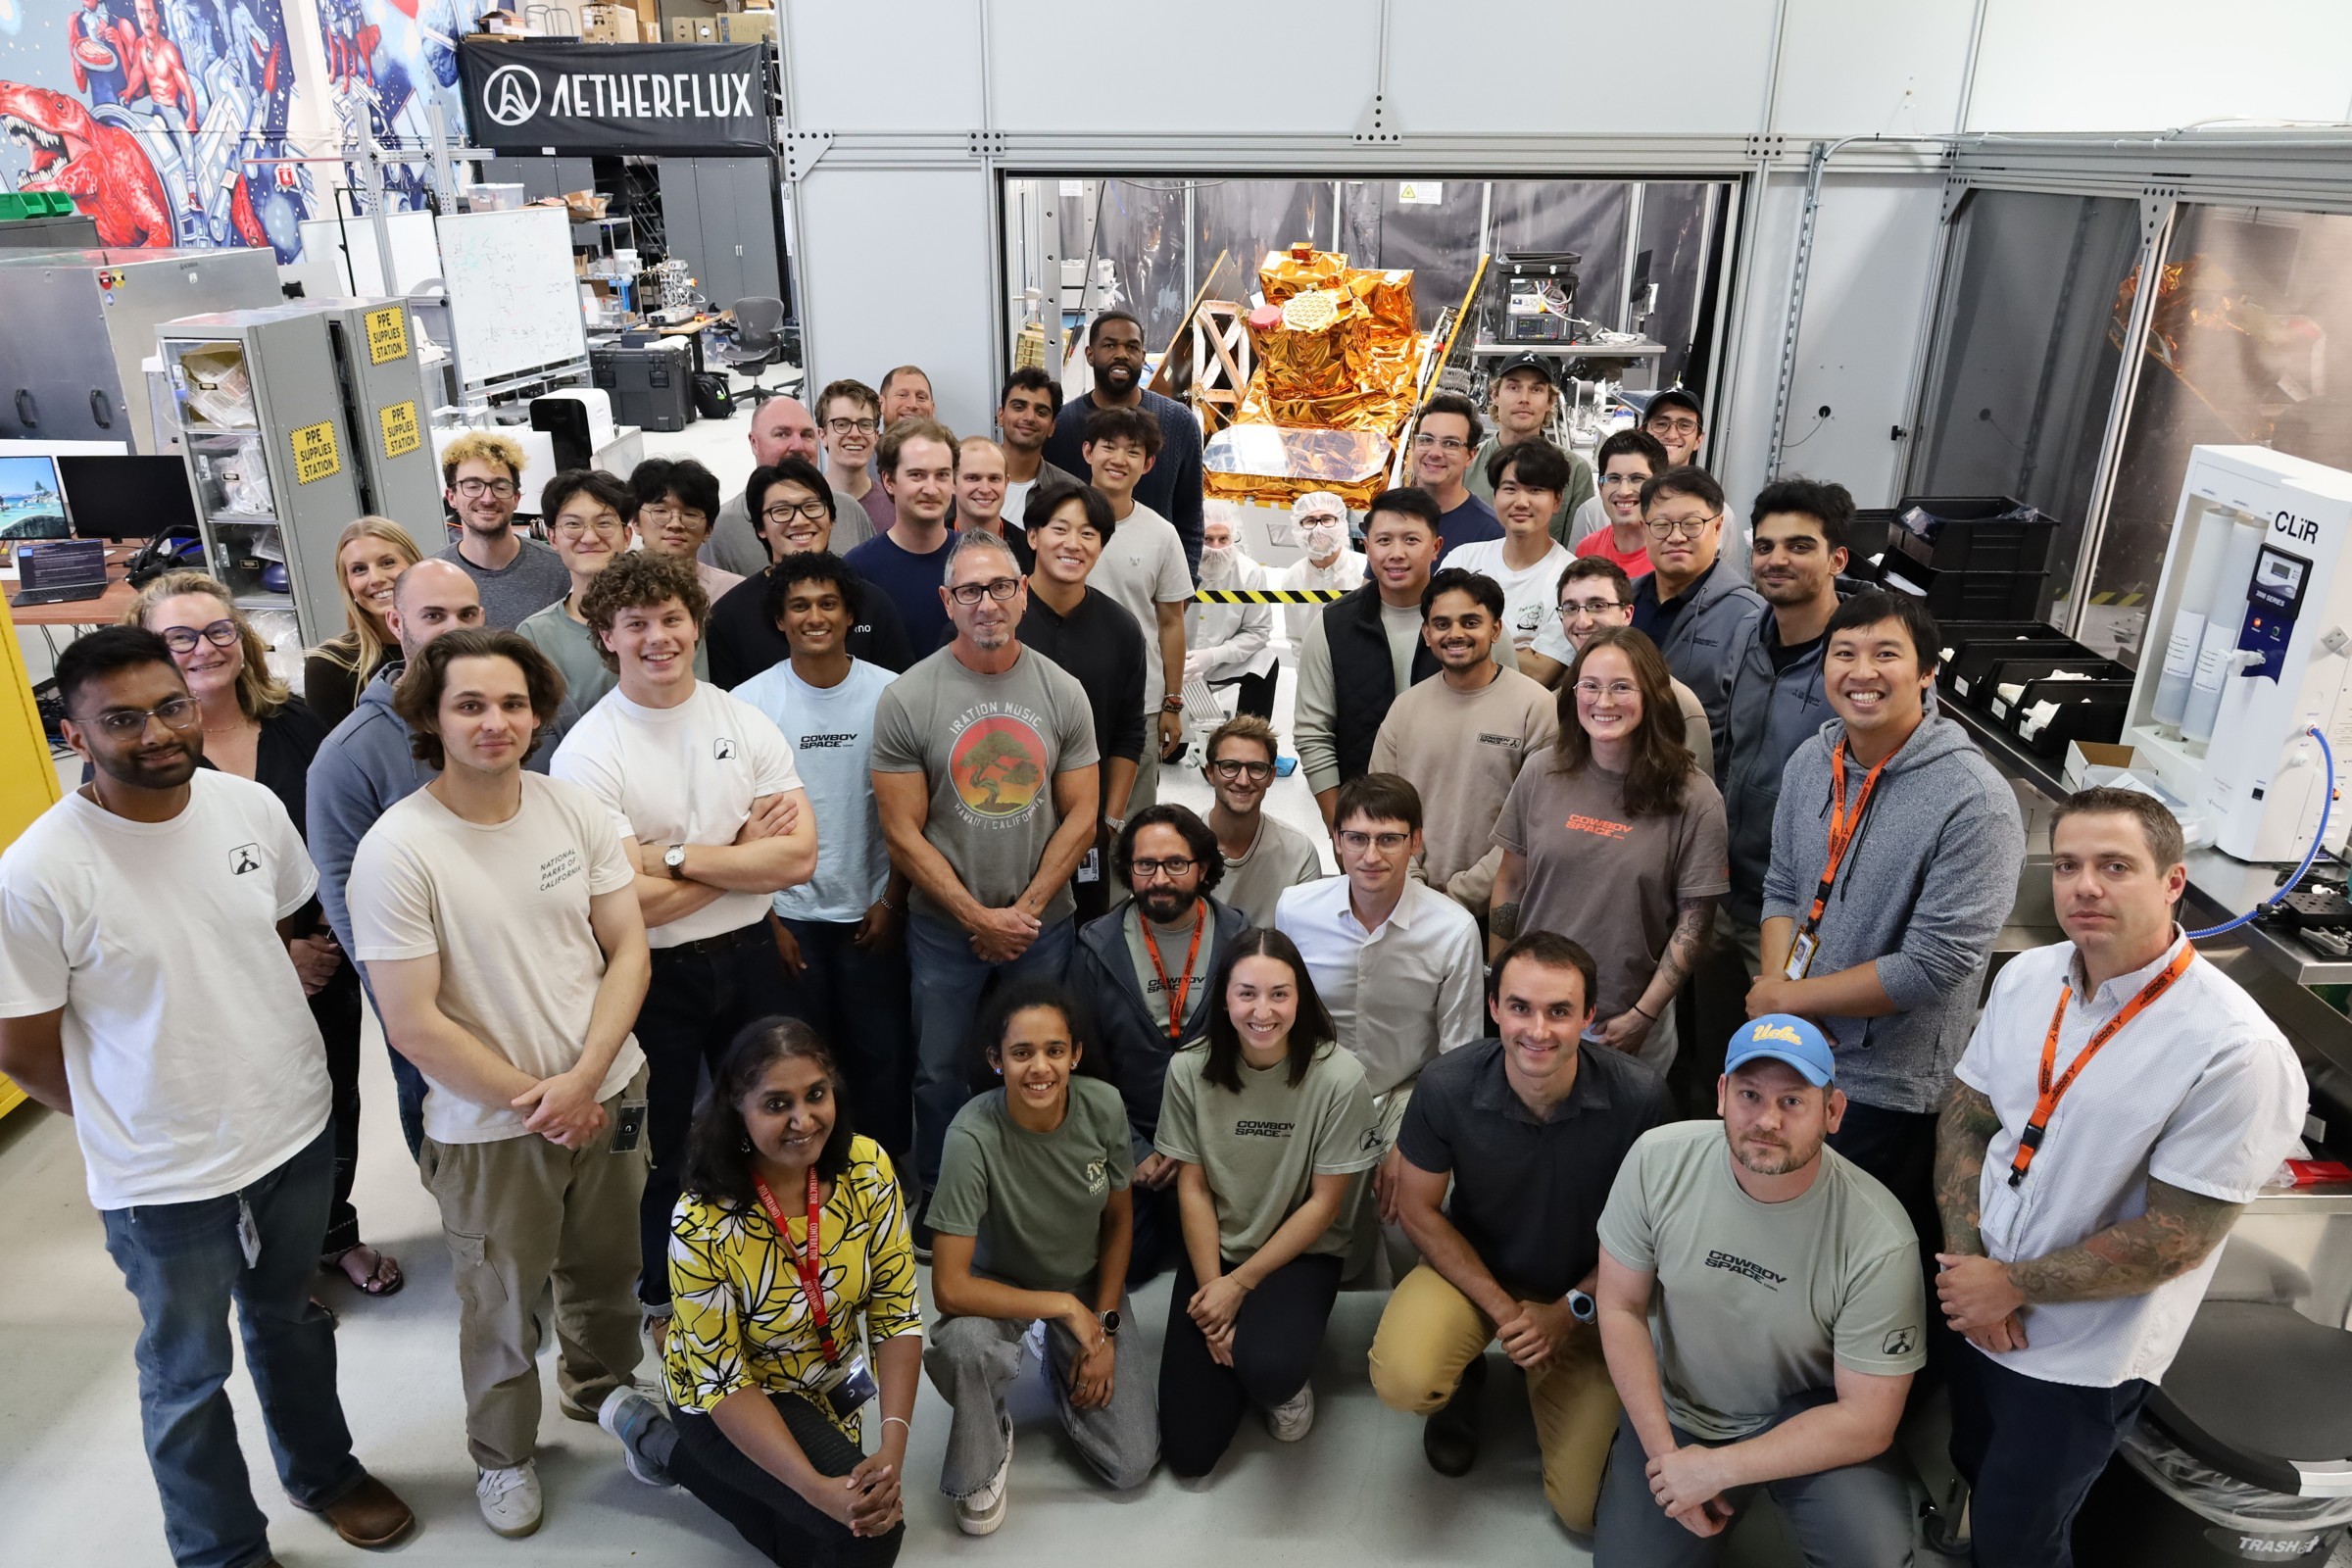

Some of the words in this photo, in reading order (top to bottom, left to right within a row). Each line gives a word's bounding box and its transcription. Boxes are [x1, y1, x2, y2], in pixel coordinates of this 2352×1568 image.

[550, 74, 754, 118] AETHERFLUX
[377, 313, 391, 328] PPE
[372, 327, 401, 344] SUPPLIES
[376, 342, 403, 359] STATION
[392, 407, 406, 422] PPE
[305, 428, 322, 446] PPE
[387, 419, 414, 437] SUPPLIES
[300, 442, 332, 463] SUPPLIES
[390, 435, 416, 452] STATION
[304, 458, 334, 477] STATION
[2266, 595, 2285, 608] SERIES
[949, 702, 998, 734] IRATION
[1004, 702, 1043, 727] MUSIC
[800, 741, 842, 750] SPACE
[801, 733, 858, 743] COWBOY
[955, 803, 980, 827] HAWAII
[992, 797, 1046, 830] CALIFORNIA
[1565, 820, 1615, 837] SPACE
[1569, 813, 1634, 833] COWBOY
[540, 848, 575, 872] NATIONAL
[542, 862, 565, 881] PARKS
[567, 857, 576, 866] OF
[540, 865, 581, 891] CALIFORNIA
[1147, 983, 1188, 994] SPAC
[1148, 976, 1205, 986] COWOY
[1235, 1128, 1281, 1138] SPACE
[1237, 1120, 1296, 1130] COWBOY
[757, 1183, 781, 1218] CONTRACTOR
[808, 1222, 818, 1260] CONTRACTOR
[1705, 1257, 1765, 1285] SPACE
[1708, 1250, 1788, 1284] COWBOY
[803, 1279, 822, 1312] CONTRACTOR
[2239, 1537, 2300, 1553] TRASH
